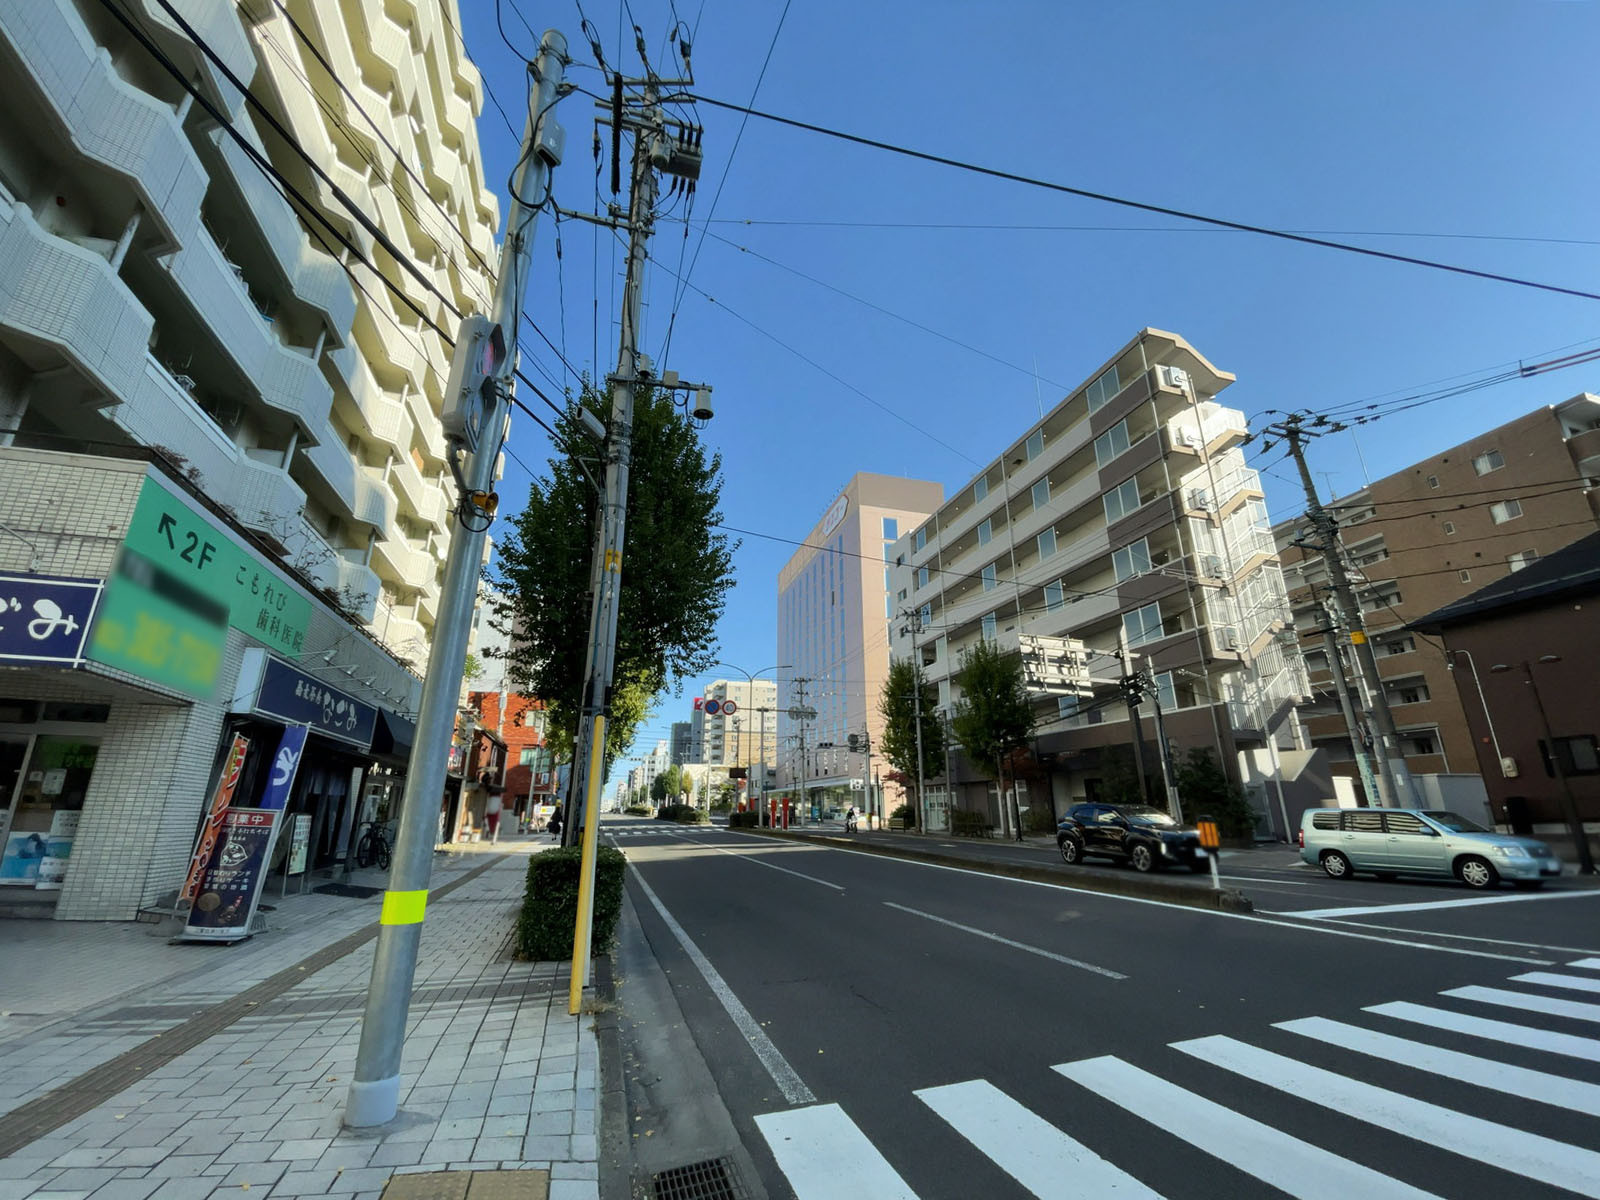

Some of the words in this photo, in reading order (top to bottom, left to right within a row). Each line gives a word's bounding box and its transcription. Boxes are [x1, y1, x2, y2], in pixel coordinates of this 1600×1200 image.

[180, 531, 217, 569] 2F
[236, 565, 289, 611] こもれび
[256, 607, 304, 652] 歯科医院
